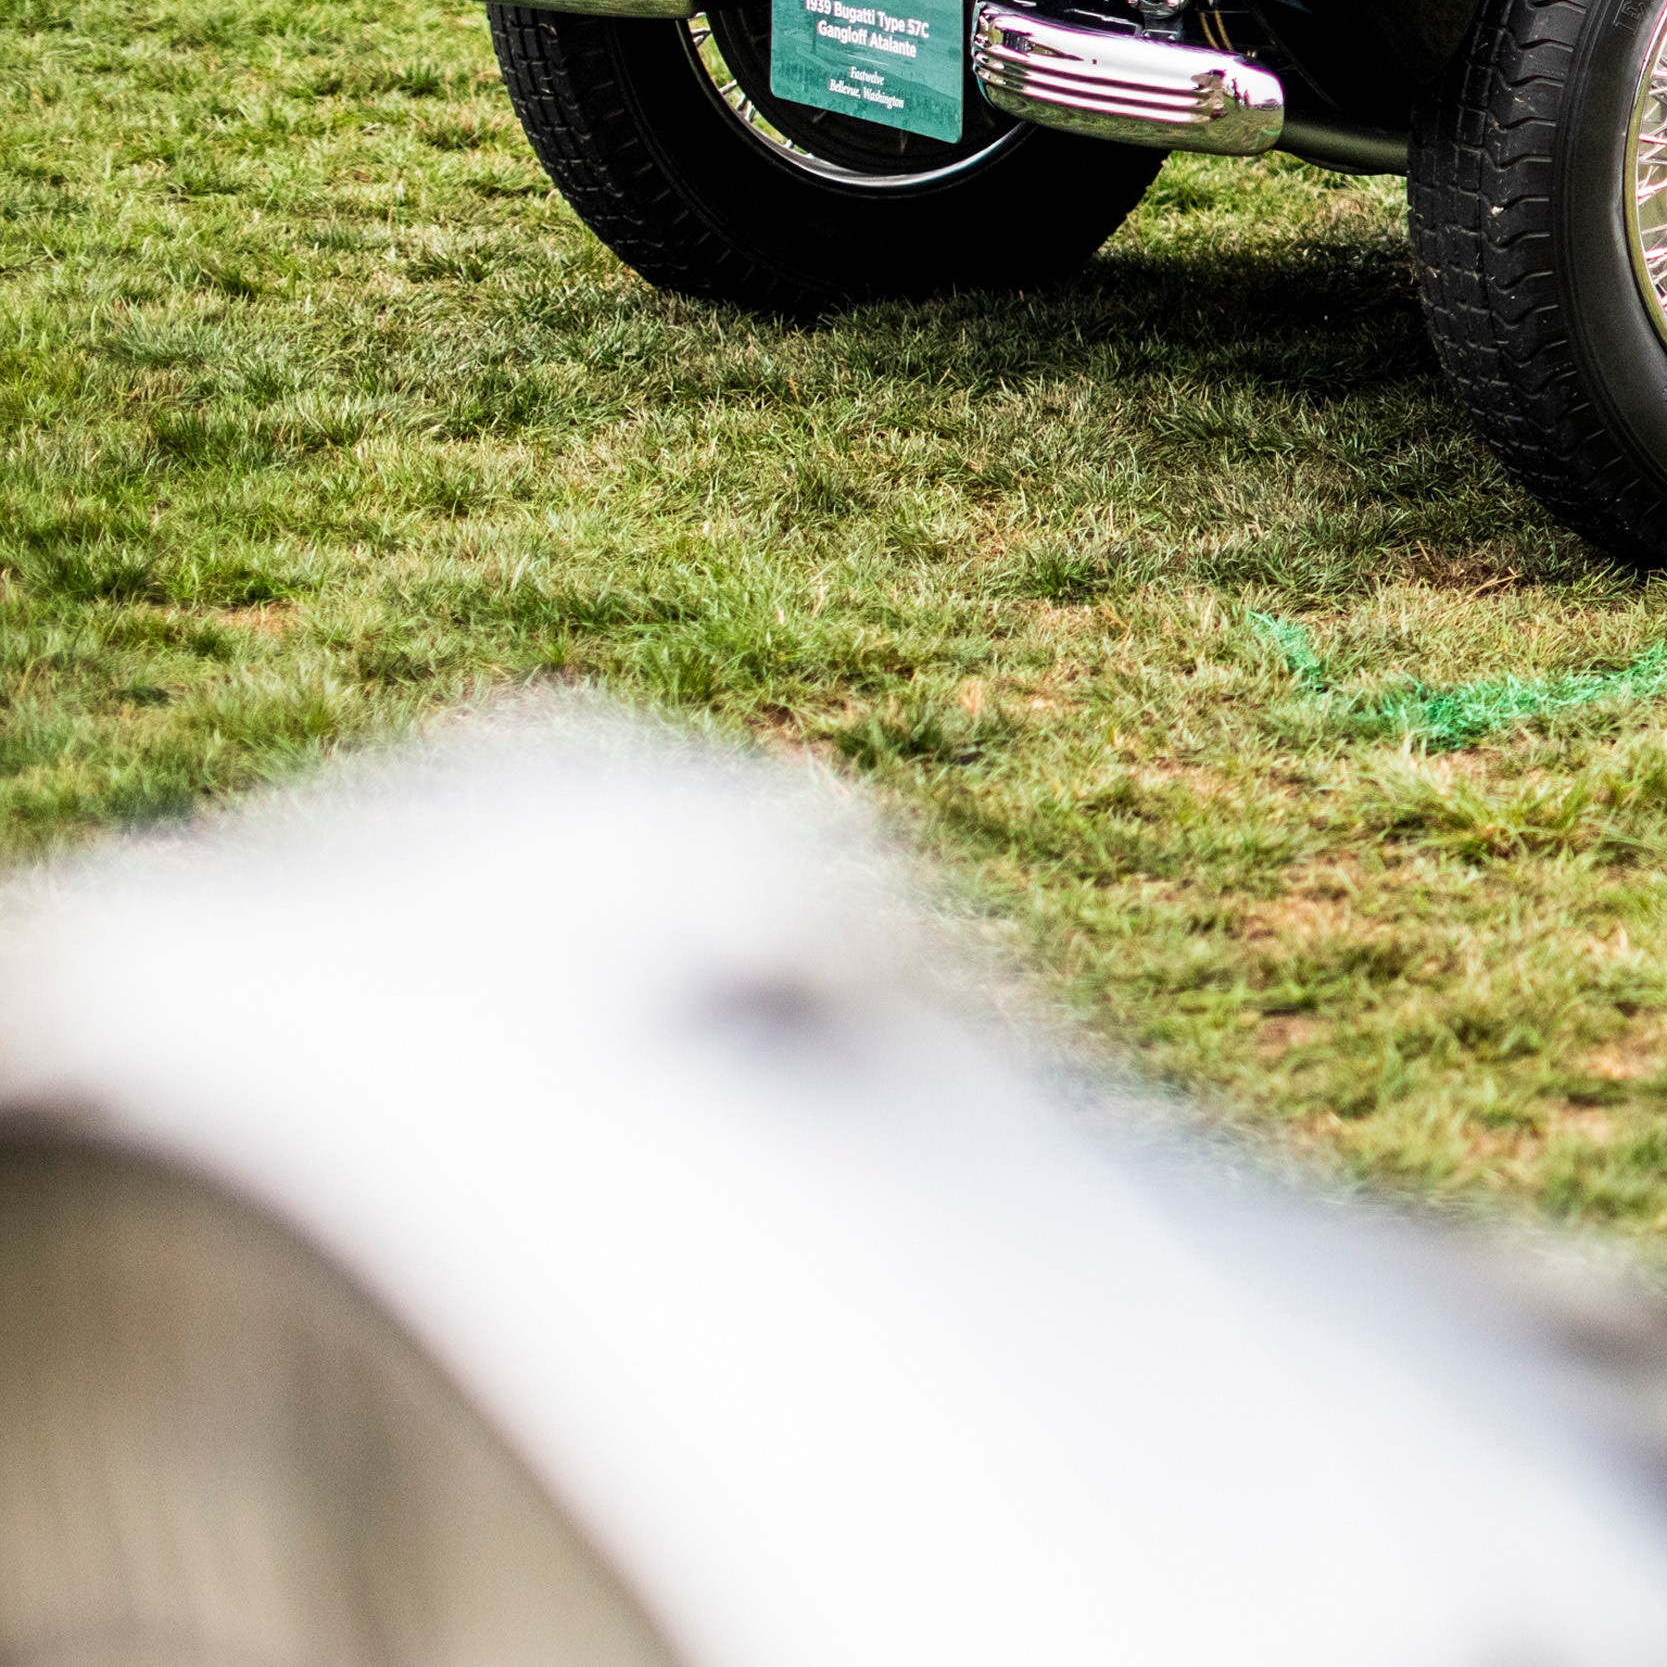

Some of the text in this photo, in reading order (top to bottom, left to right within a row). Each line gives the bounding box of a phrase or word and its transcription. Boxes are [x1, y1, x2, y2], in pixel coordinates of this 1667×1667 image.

[816, 19, 917, 58] Gangloff Atalante
[833, 0, 876, 25] Bugatti
[877, 11, 906, 33] Type
[906, 18, 930, 39] 57C
[828, 78, 905, 110] Bellevue, Washington
